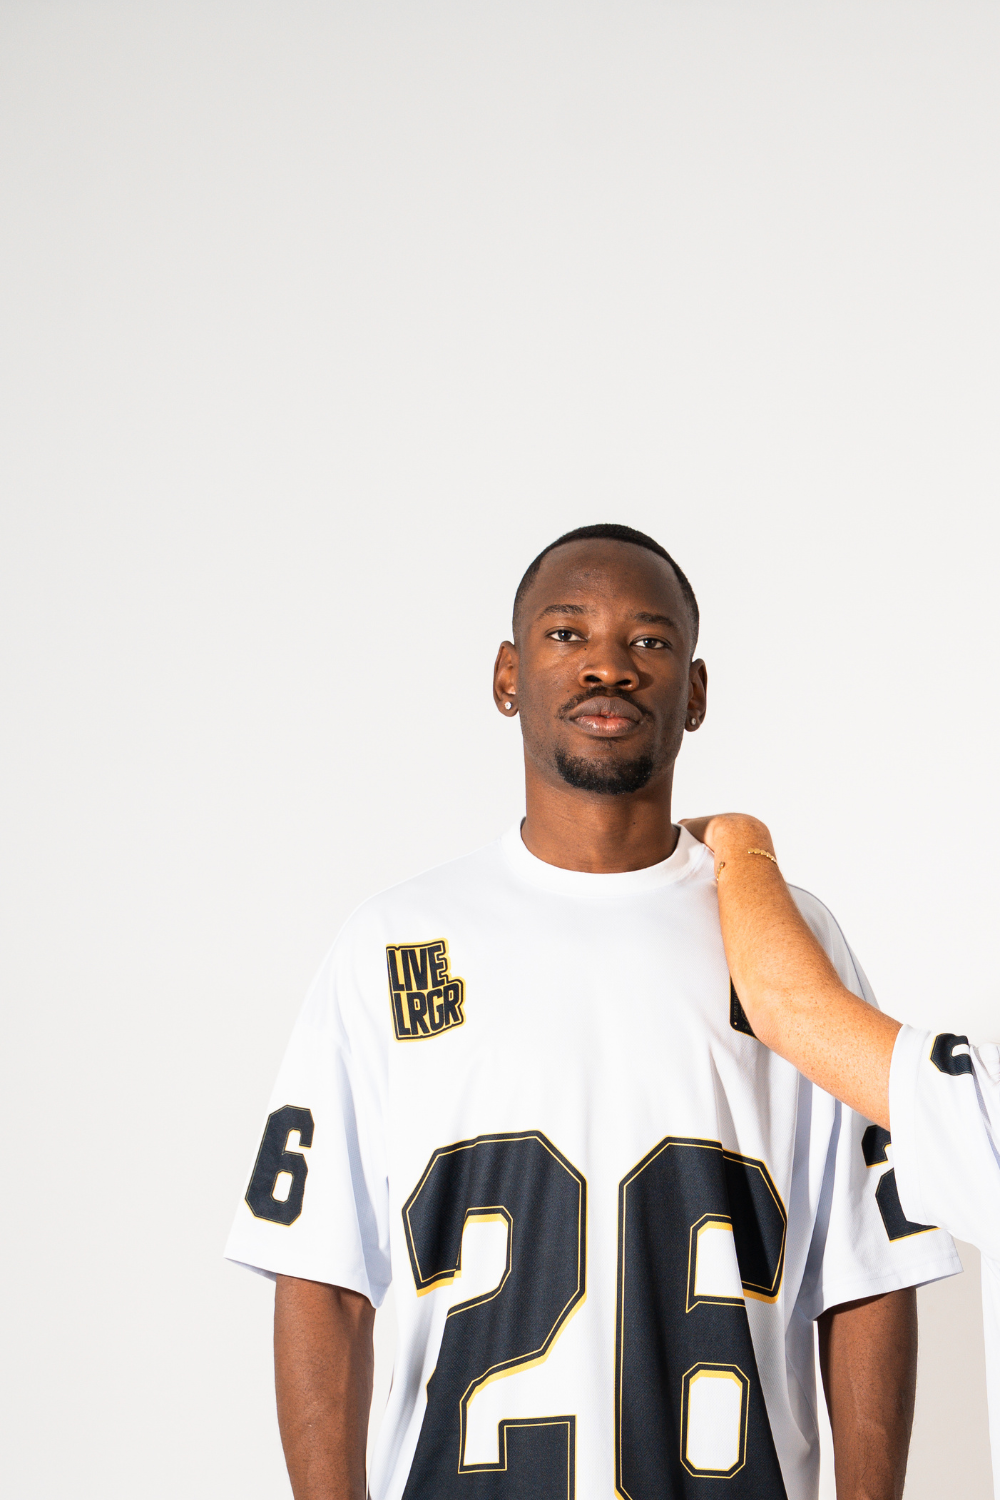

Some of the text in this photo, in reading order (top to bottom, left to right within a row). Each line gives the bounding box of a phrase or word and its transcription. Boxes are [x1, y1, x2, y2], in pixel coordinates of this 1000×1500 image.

[387, 943, 447, 992] LIVE
[393, 982, 461, 1036] LRGR
[244, 1104, 315, 1227] 6
